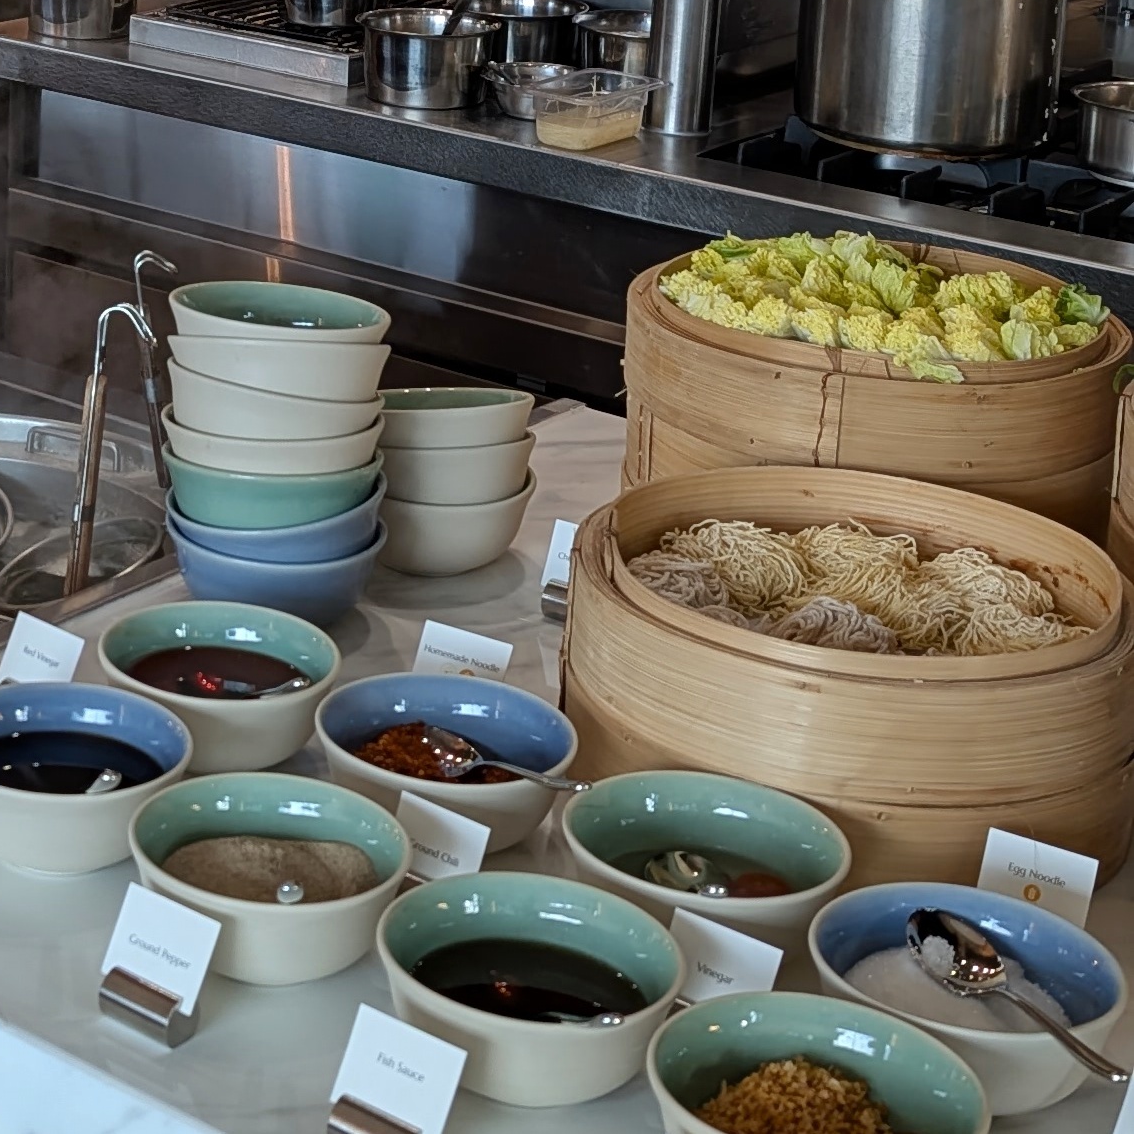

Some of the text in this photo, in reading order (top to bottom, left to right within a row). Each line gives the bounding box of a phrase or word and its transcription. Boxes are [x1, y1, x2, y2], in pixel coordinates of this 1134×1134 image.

[423, 643, 500, 673] Homemade Noodle
[1008, 861, 1066, 888] Egg Noodle
[129, 933, 192, 969] Ground Pepper
[697, 961, 734, 984] Vinegar
[376, 1051, 425, 1082] Fish Sauce
